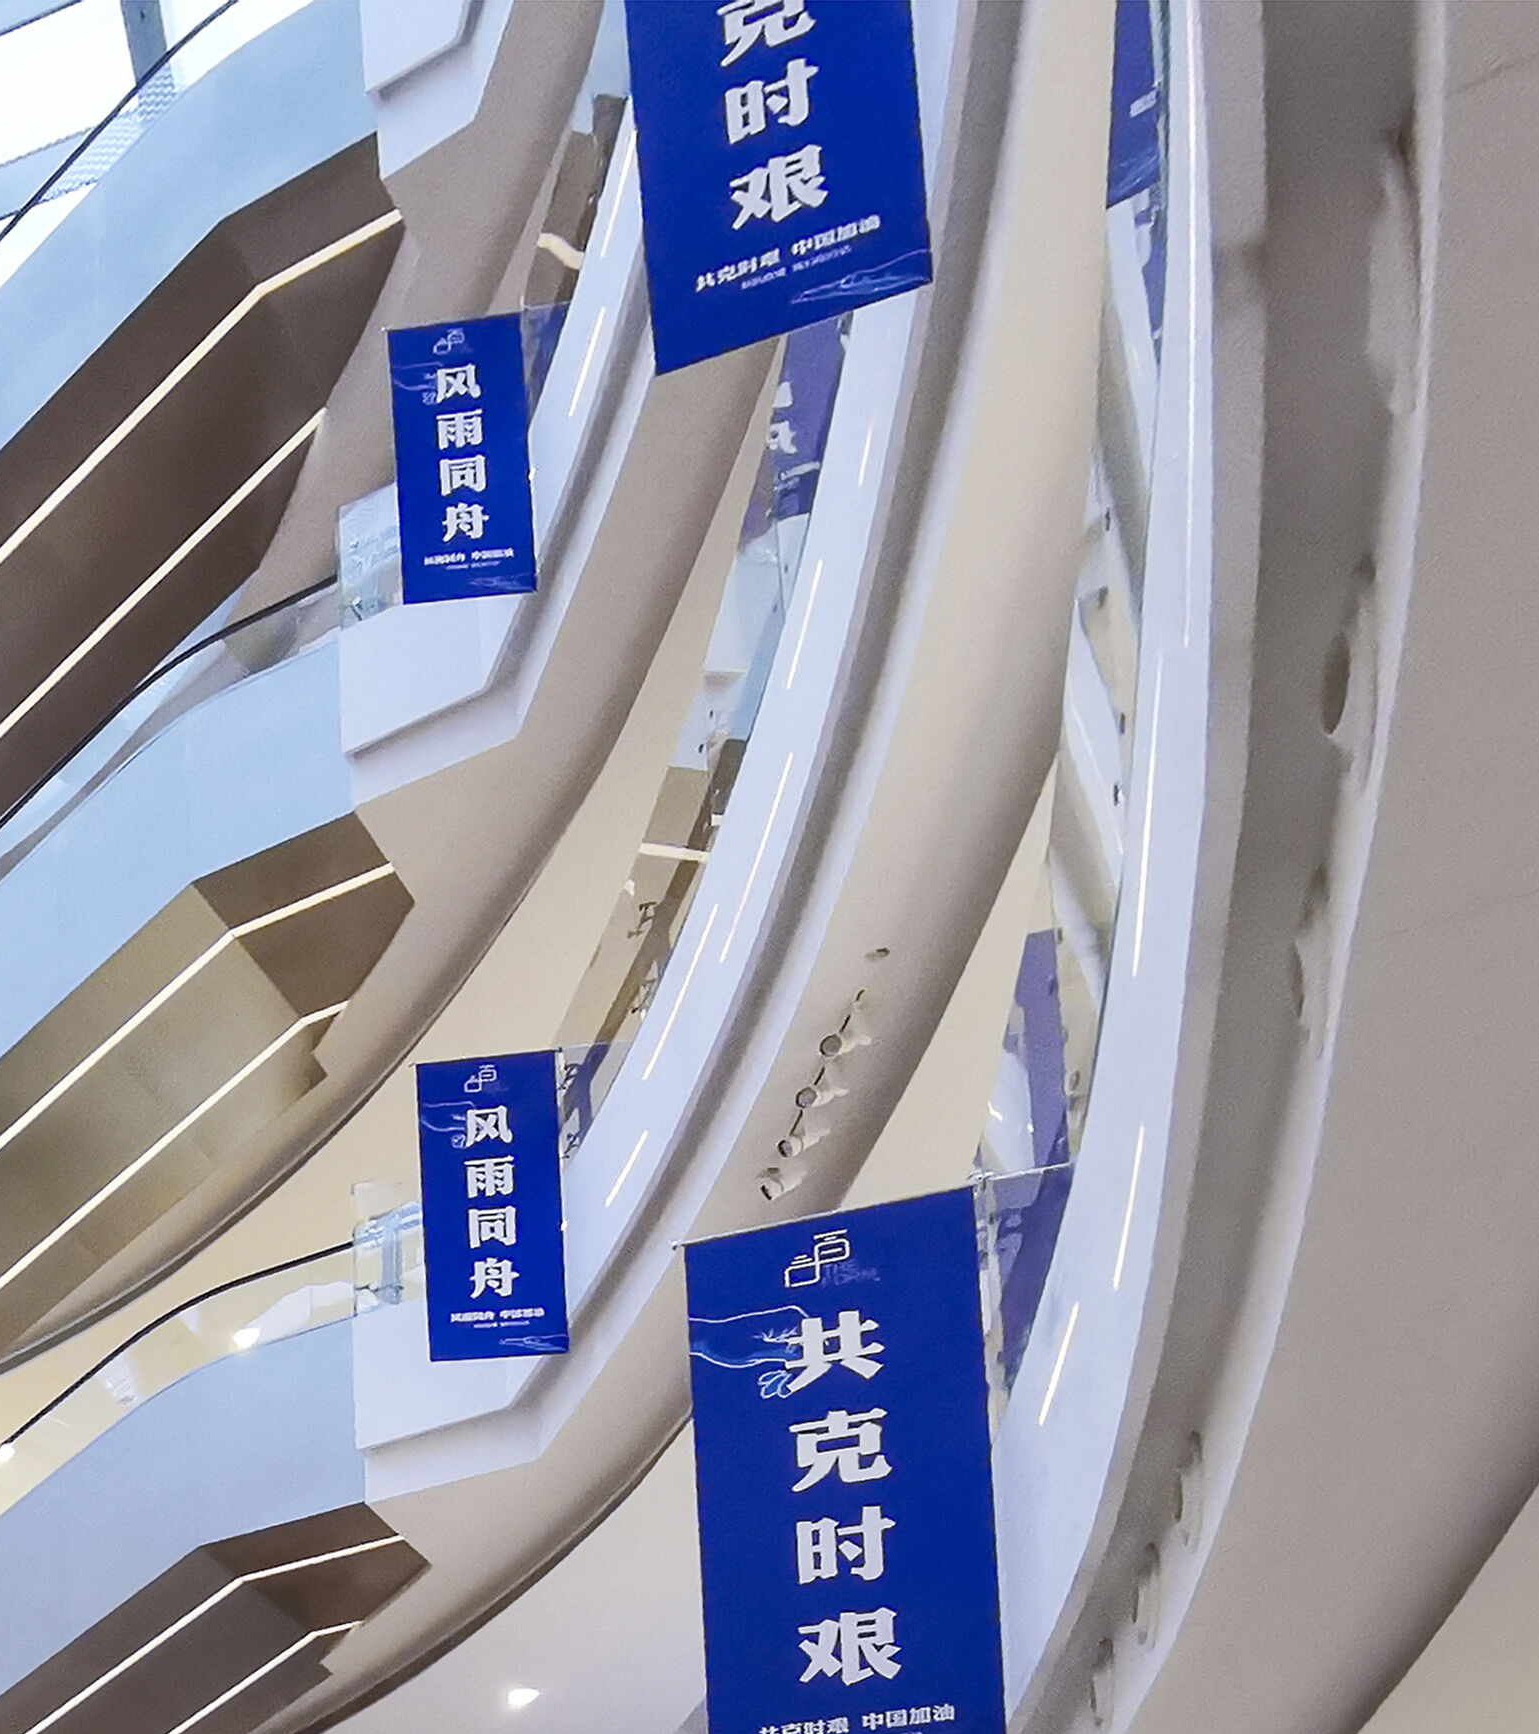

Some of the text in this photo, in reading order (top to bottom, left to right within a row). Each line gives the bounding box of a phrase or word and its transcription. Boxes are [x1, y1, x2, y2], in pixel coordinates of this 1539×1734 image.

[436, 363, 489, 542] 风雨同舟
[463, 1105, 520, 1299] 风雨同舟
[785, 1310, 902, 1686] 共克时艰
[862, 1703, 956, 1731] 中国加油
